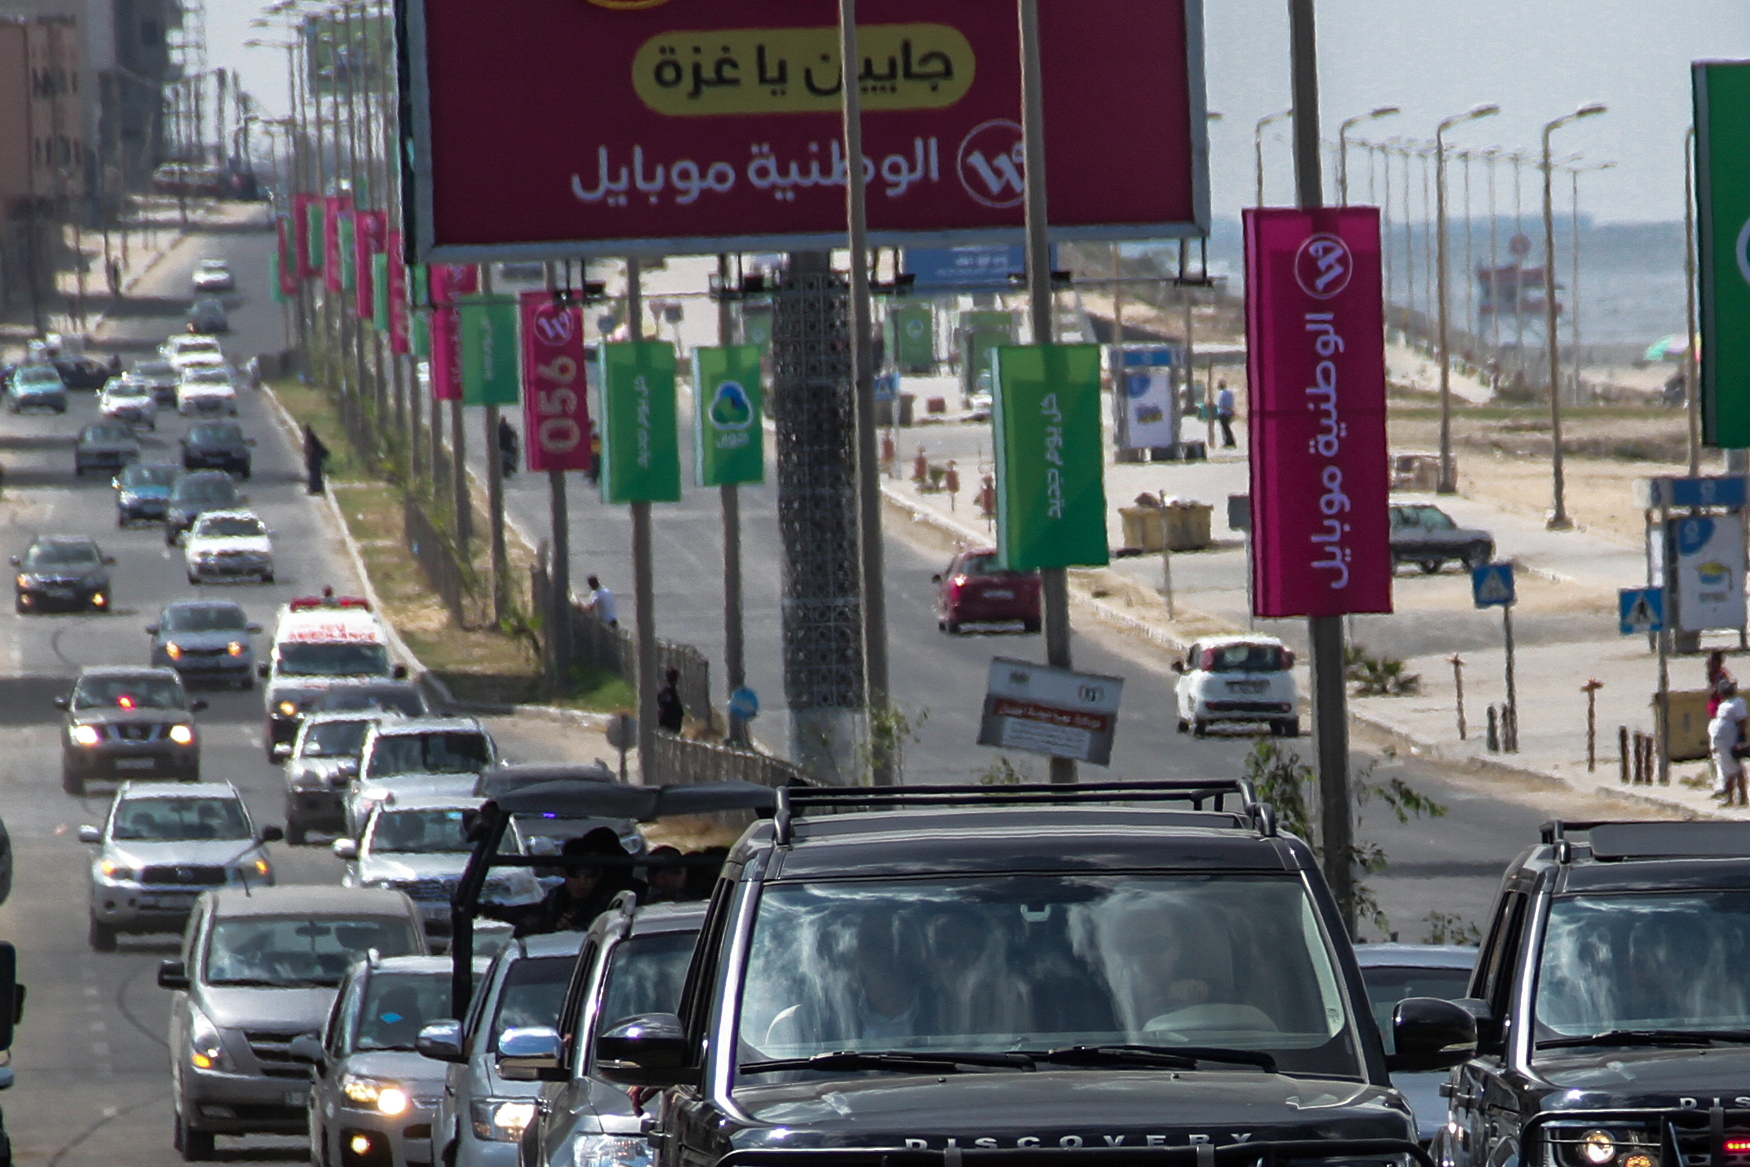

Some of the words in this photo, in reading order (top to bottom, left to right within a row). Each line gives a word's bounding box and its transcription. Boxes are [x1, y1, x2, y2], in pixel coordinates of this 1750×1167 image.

[653, 44, 742, 100] غزة
[755, 43, 788, 96] يا
[570, 144, 736, 206] موبايل
[537, 355, 582, 455] 056
[1305, 312, 1346, 458] الوطنية
[1311, 464, 1352, 590] موبايل
[904, 1133, 1252, 1150] DISCOVERY
